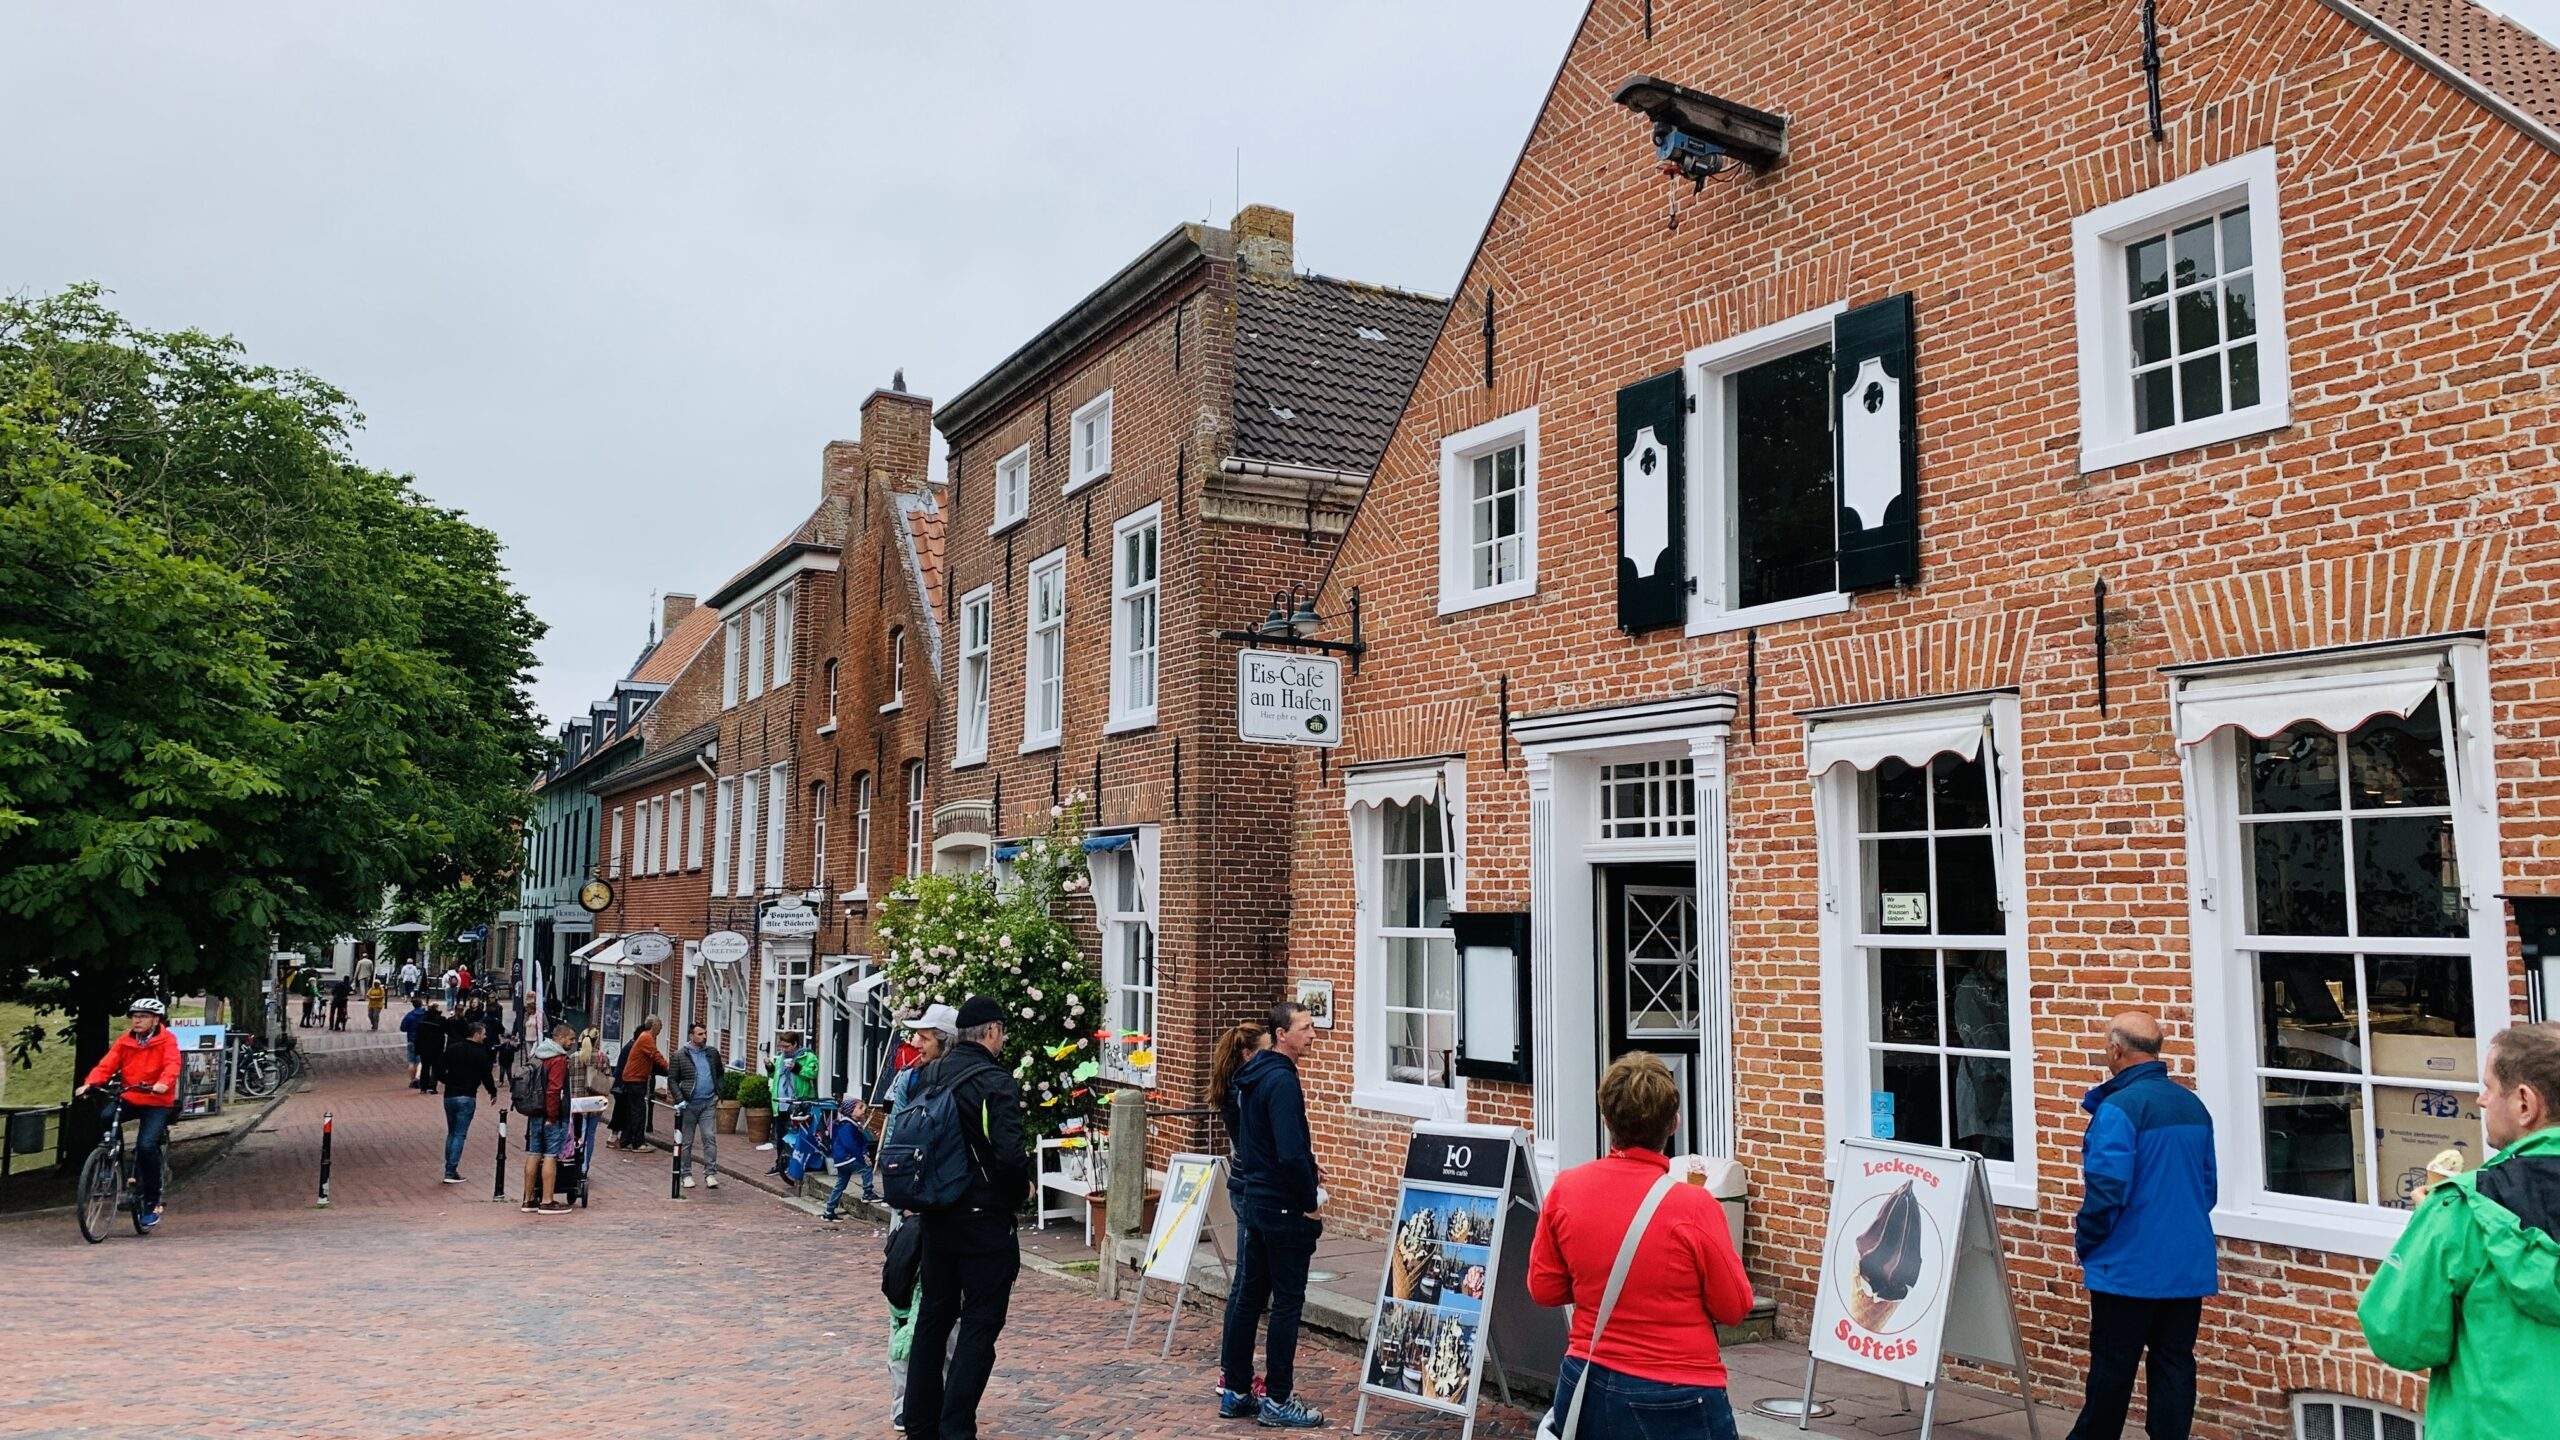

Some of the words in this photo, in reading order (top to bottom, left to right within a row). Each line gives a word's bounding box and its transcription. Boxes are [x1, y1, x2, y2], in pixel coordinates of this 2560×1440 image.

[1250, 663, 1324, 688] Eis-Café
[1250, 691, 1274, 706] am
[1281, 689, 1331, 711] Hafen
[783, 919, 815, 927] Bäckerei
[1862, 1157, 1941, 1189] Leckeres
[1835, 1318, 1918, 1362] Softeis
